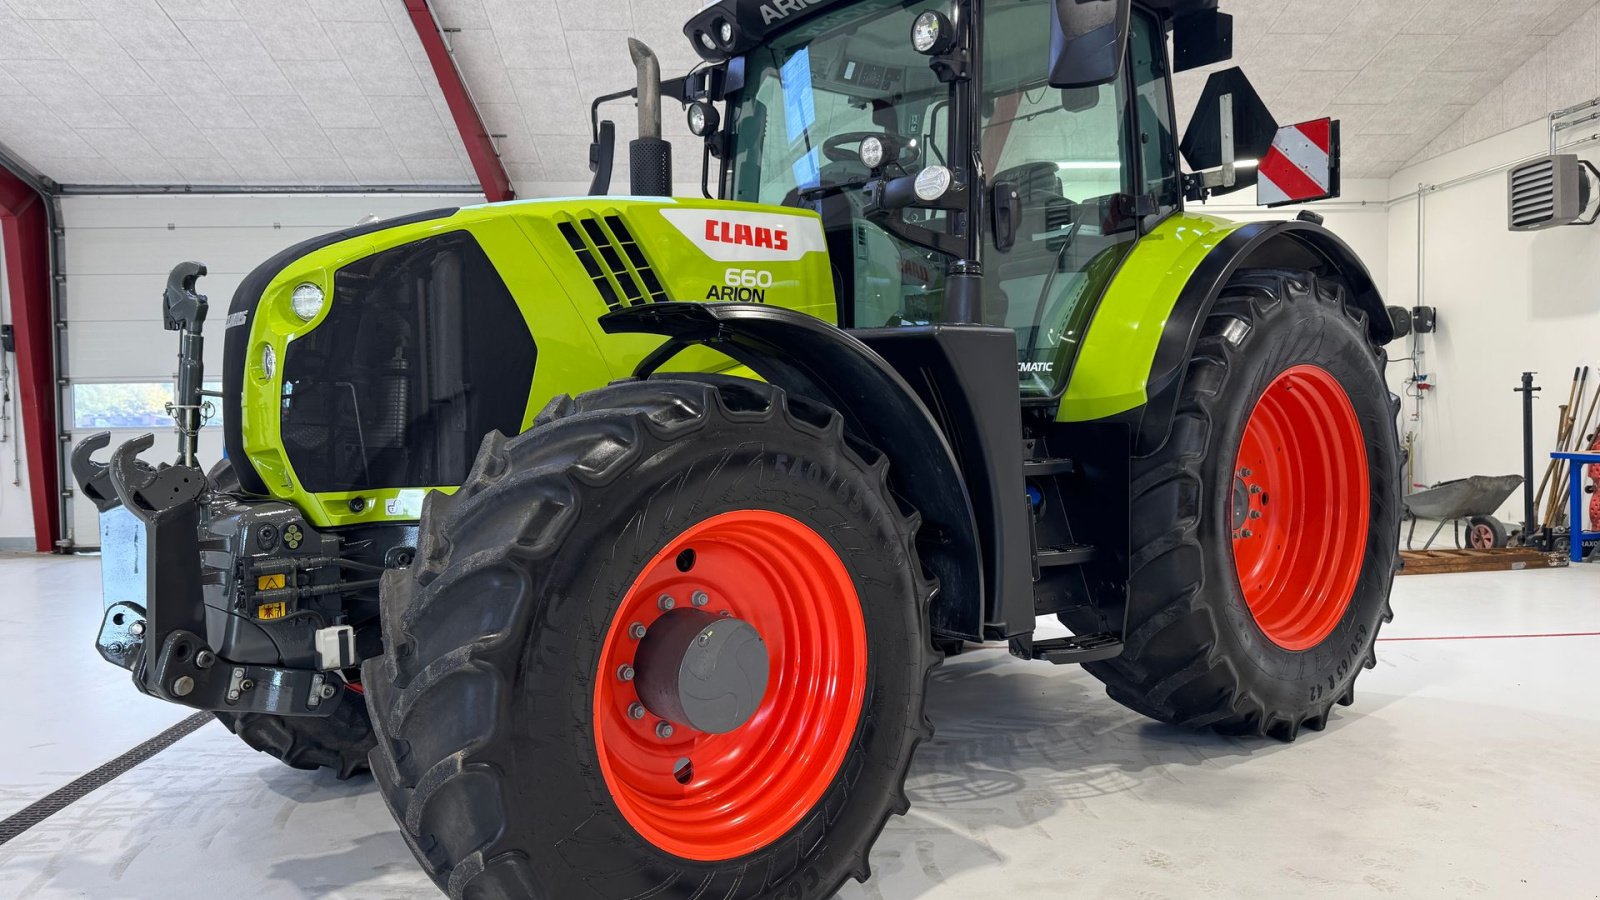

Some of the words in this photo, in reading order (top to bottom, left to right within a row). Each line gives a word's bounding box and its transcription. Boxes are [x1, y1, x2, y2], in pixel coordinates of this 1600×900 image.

[759, 0, 822, 25] AR
[705, 219, 788, 251] CLAAS
[724, 268, 772, 288] 660
[706, 285, 765, 303] ARION
[1336, 624, 1367, 680] 650/65
[1327, 674, 1335, 690] R
[1309, 683, 1323, 702] 42
